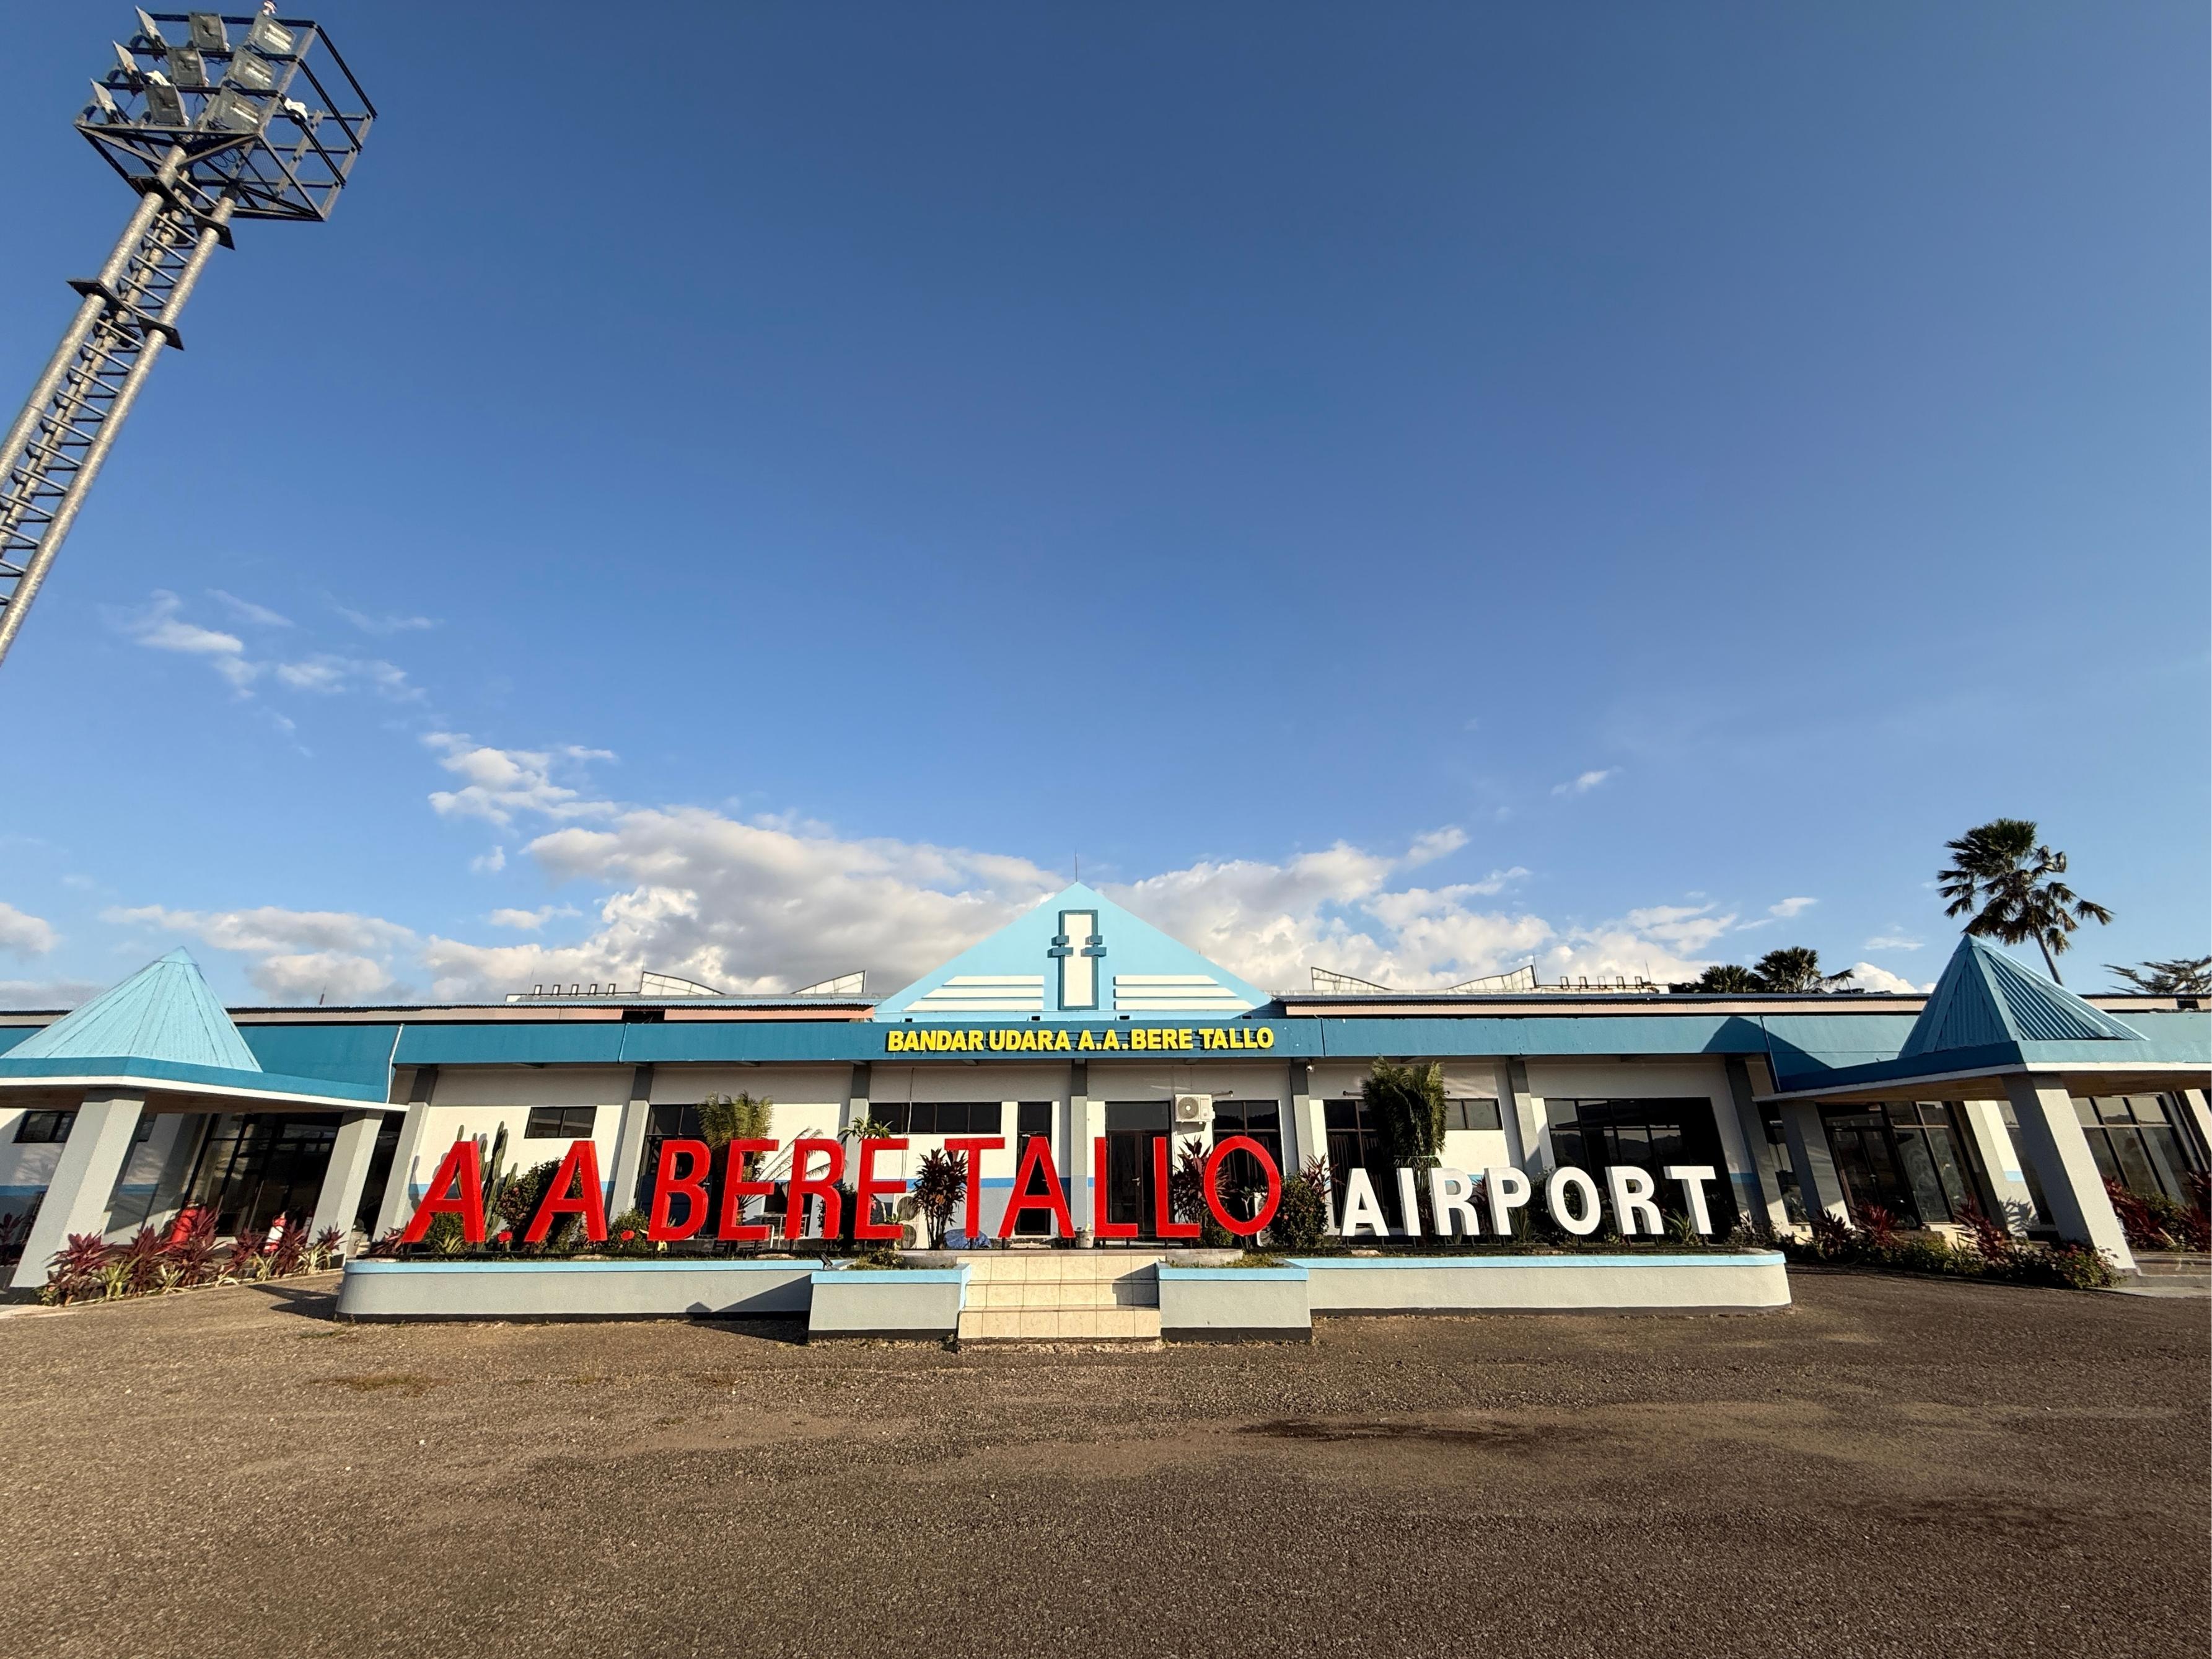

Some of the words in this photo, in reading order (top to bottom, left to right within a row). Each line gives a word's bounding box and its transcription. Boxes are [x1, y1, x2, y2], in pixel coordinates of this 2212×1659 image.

[888, 1030, 983, 1052] BANDAR
[988, 1030, 1070, 1050] UDARA
[1198, 1028, 1274, 1049] TALLO
[944, 1135, 1282, 1238] TALLO
[1340, 1165, 1716, 1236] AIRPORT
